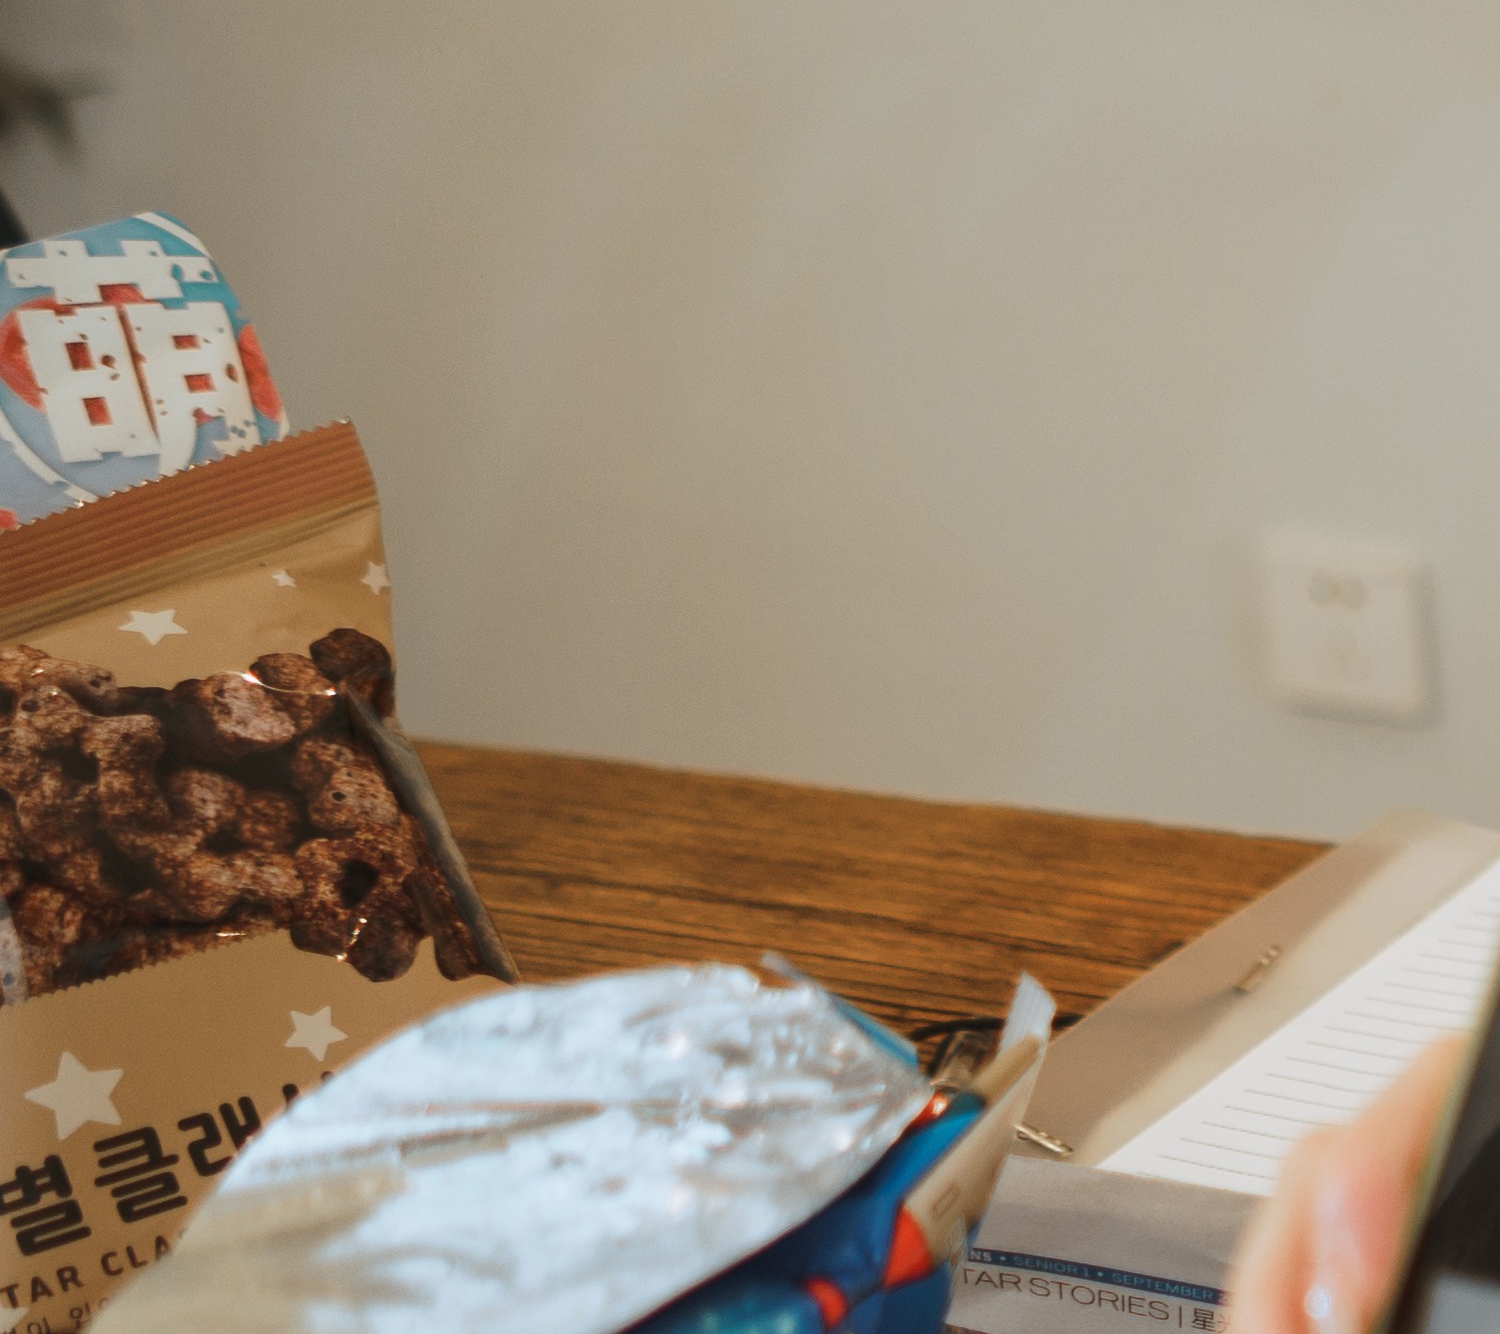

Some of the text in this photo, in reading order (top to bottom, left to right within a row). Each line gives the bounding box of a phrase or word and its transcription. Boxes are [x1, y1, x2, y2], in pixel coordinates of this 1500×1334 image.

[4, 239, 262, 475] 萌
[100, 1229, 190, 1276] CLA
[1013, 1255, 1077, 1275] SENIOR
[1112, 1272, 1214, 1300] SEPTEMBER
[962, 1268, 1170, 1322] TAR STORIES
